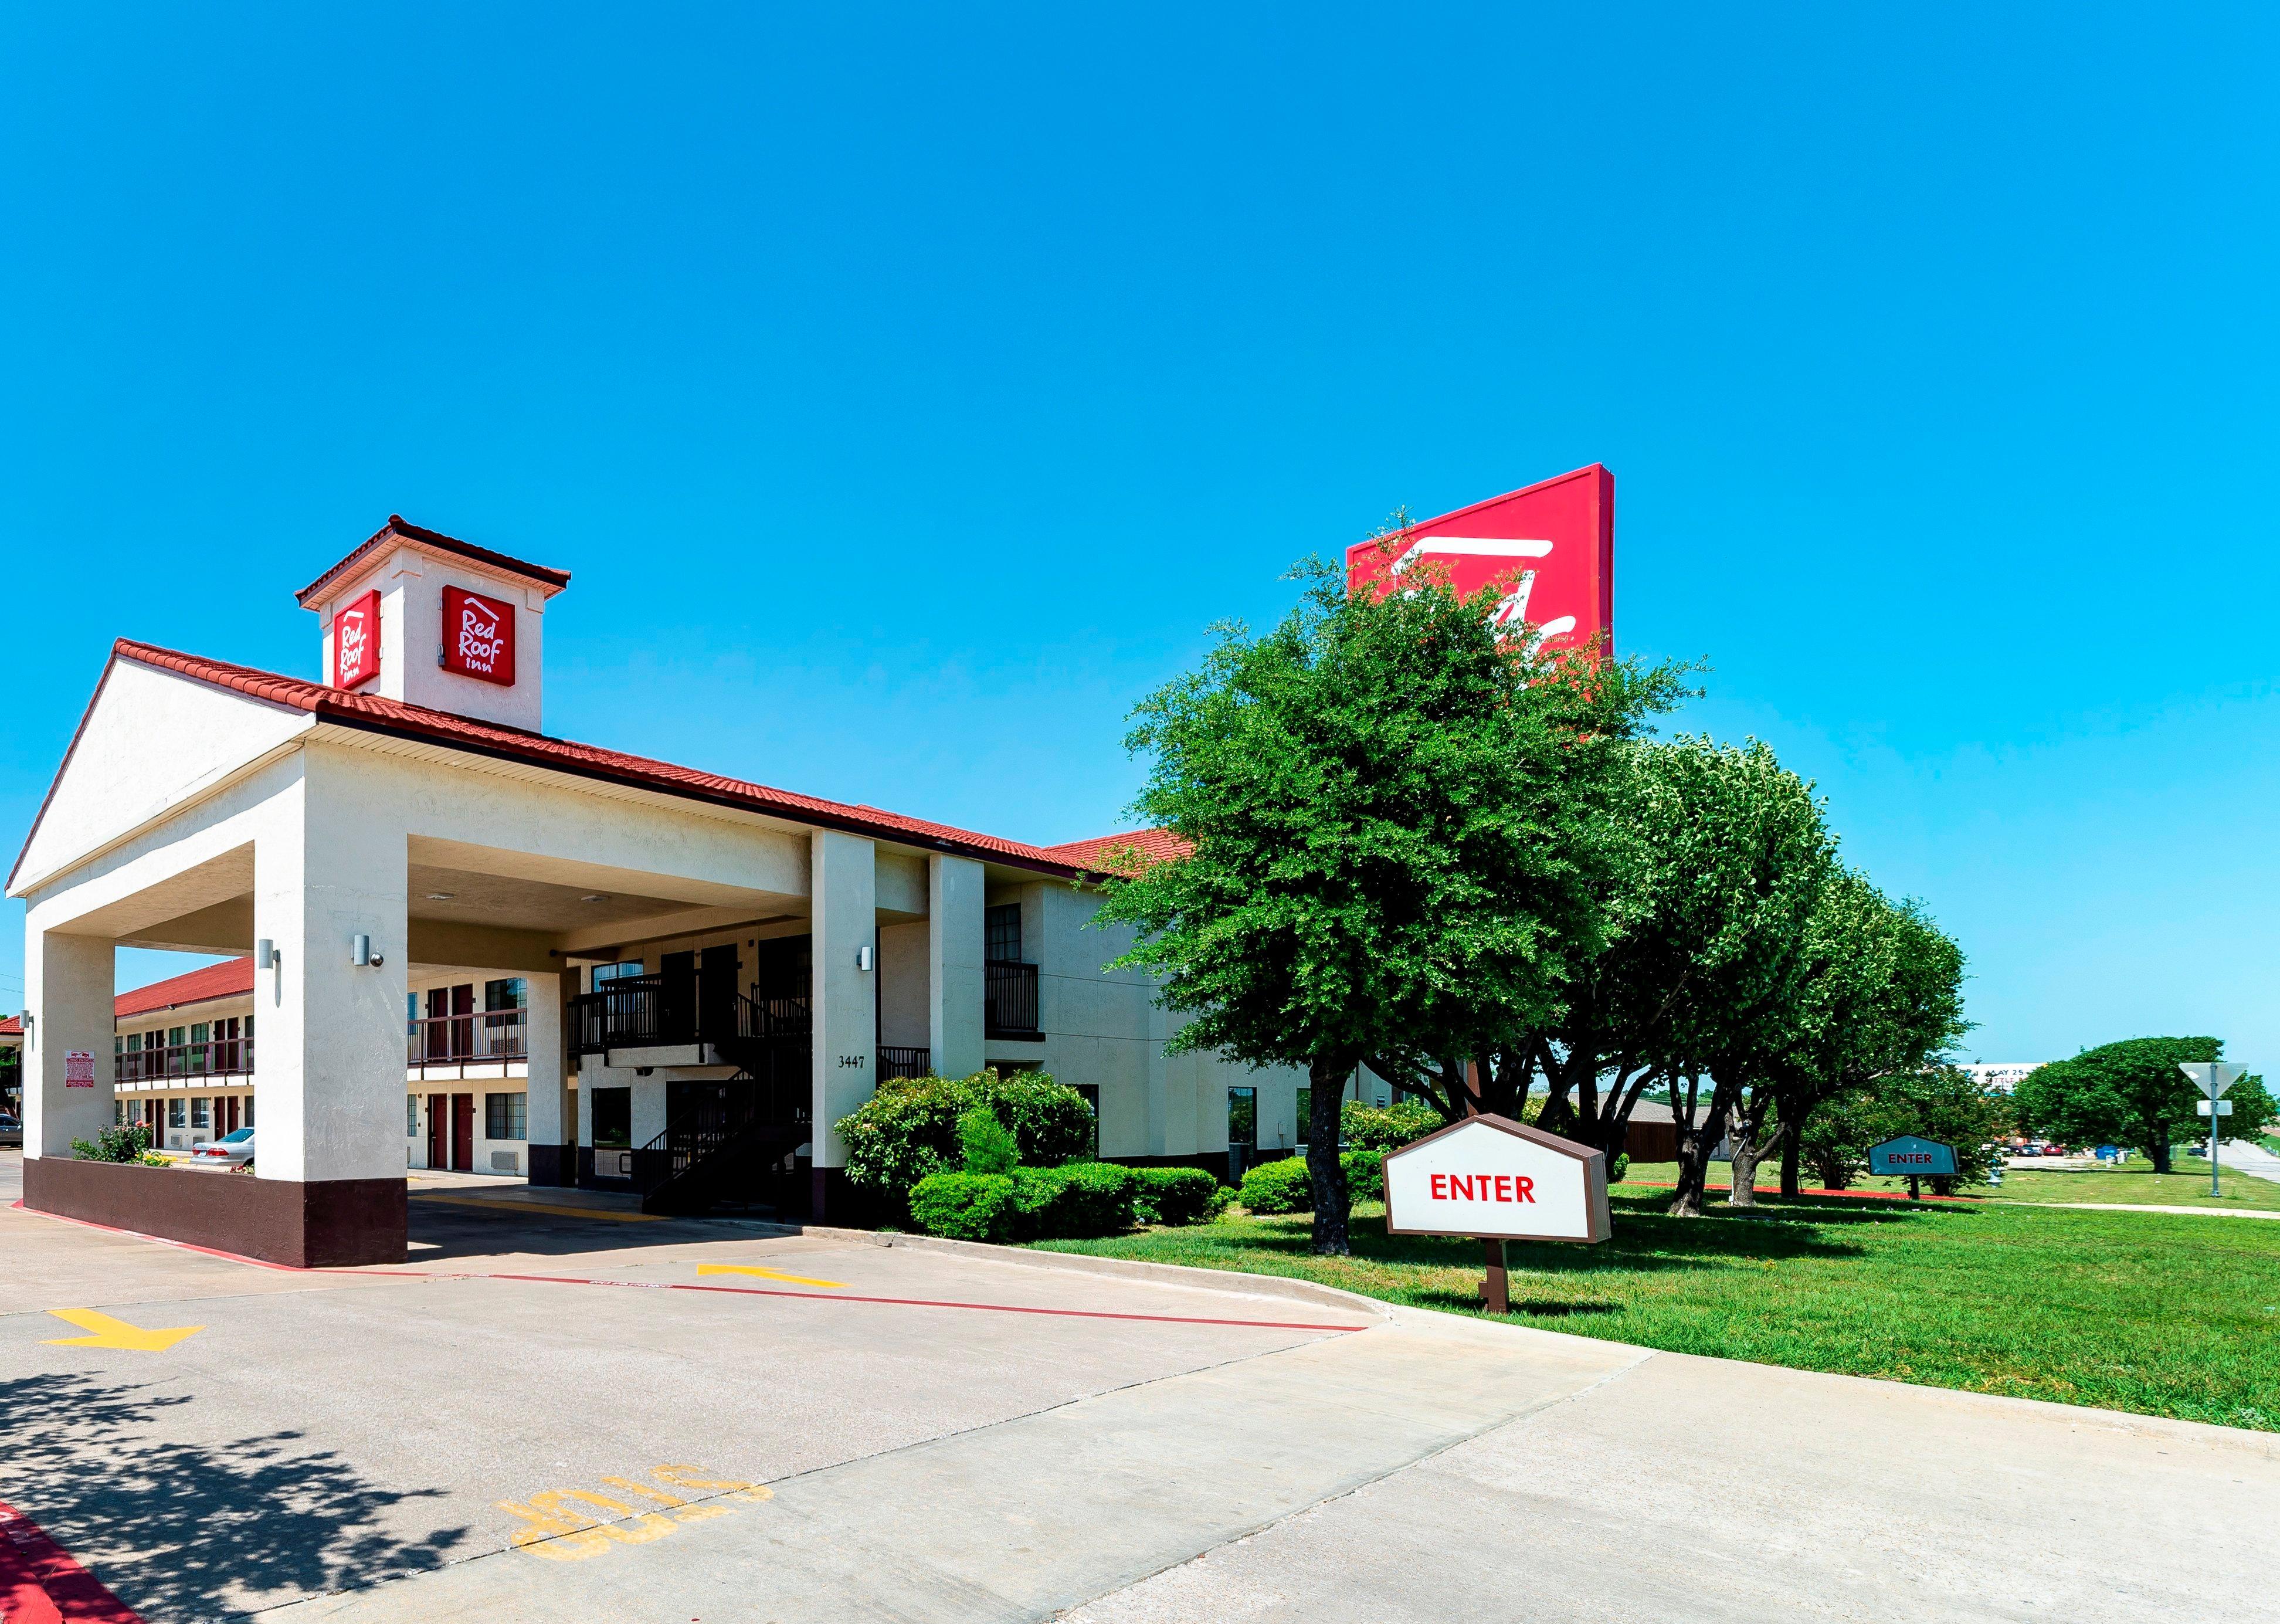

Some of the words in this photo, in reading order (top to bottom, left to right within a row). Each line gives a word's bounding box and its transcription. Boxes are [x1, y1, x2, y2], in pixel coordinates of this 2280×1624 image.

[342, 621, 362, 649] Red
[463, 610, 496, 640] Red
[340, 633, 367, 676] Roof
[459, 632, 504, 664] Roof
[838, 1056, 864, 1069] 3447
[1888, 1154, 1933, 1164] ENTER
[1430, 1174, 1536, 1203] ENTER
